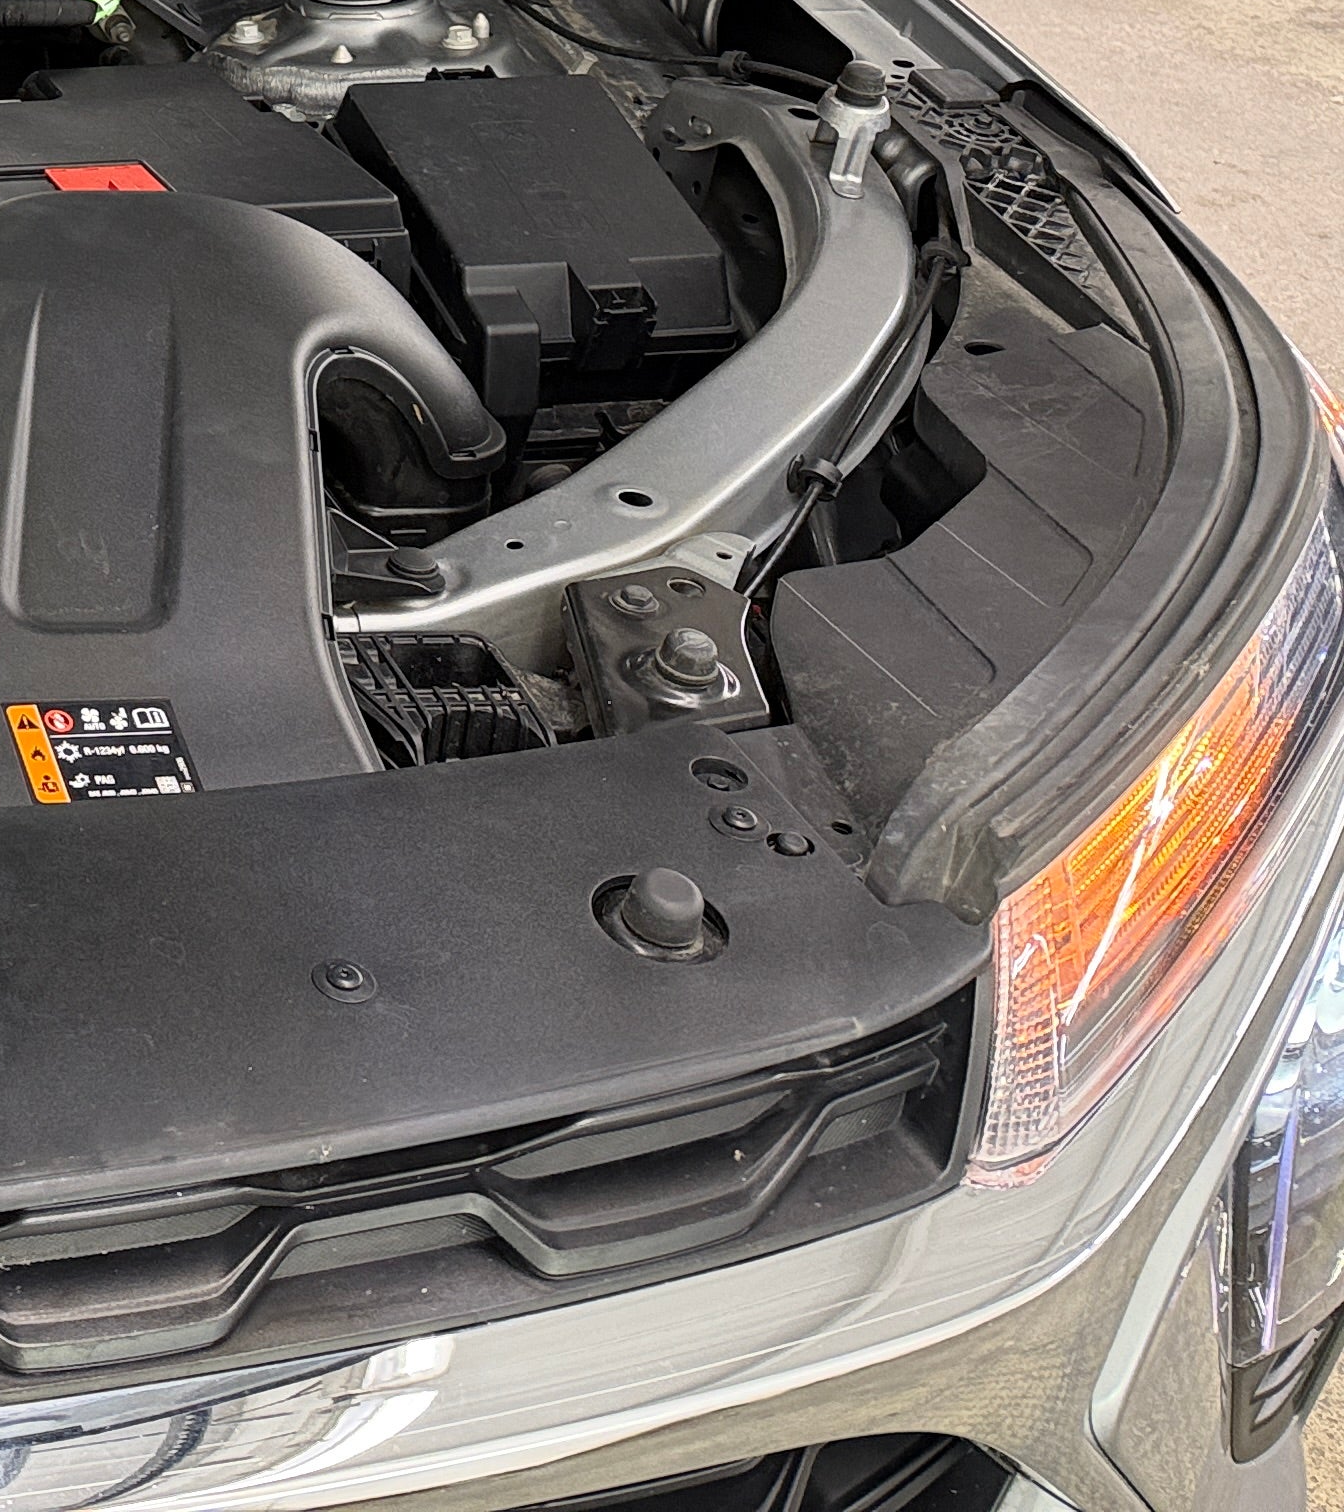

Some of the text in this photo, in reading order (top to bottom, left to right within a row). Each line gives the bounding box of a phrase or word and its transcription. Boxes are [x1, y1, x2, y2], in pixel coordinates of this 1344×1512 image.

[83, 722, 107, 731] AUTO
[156, 744, 171, 755] kg
[94, 775, 116, 785] PAG
